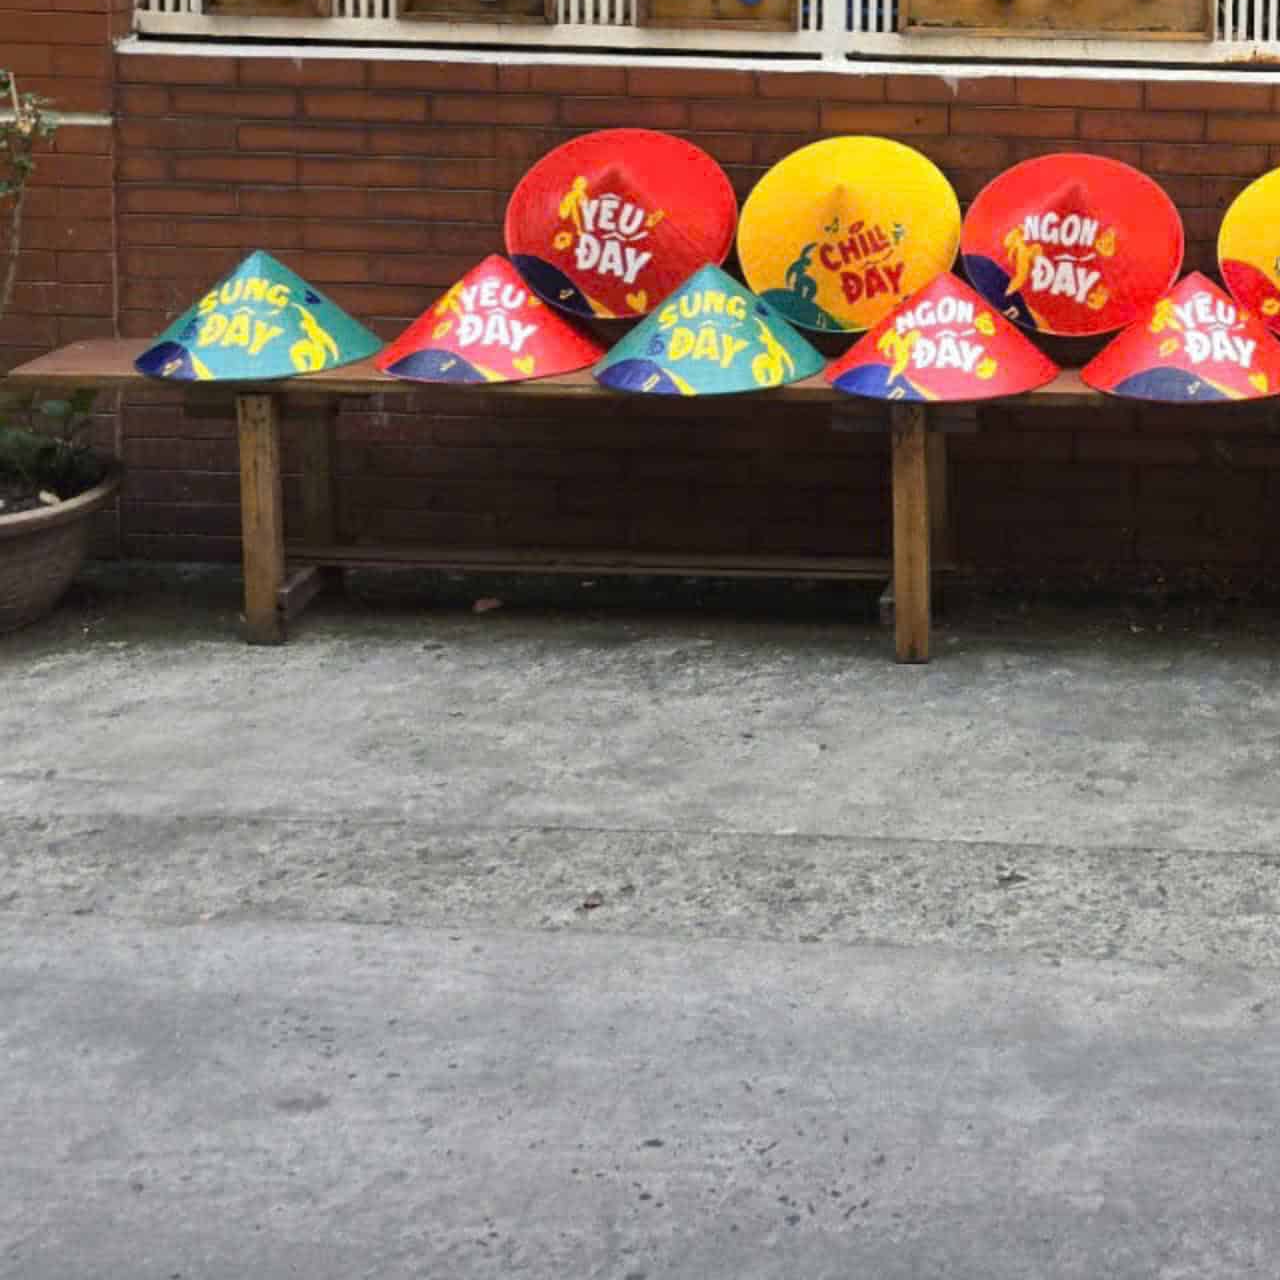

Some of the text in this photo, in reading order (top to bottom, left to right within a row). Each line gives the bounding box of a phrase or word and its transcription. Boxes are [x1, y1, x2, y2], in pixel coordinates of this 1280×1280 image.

[580, 194, 644, 233] YÊU
[1024, 213, 1099, 247] NGON
[459, 276, 526, 311] YÊU
[896, 296, 975, 334] NGON
